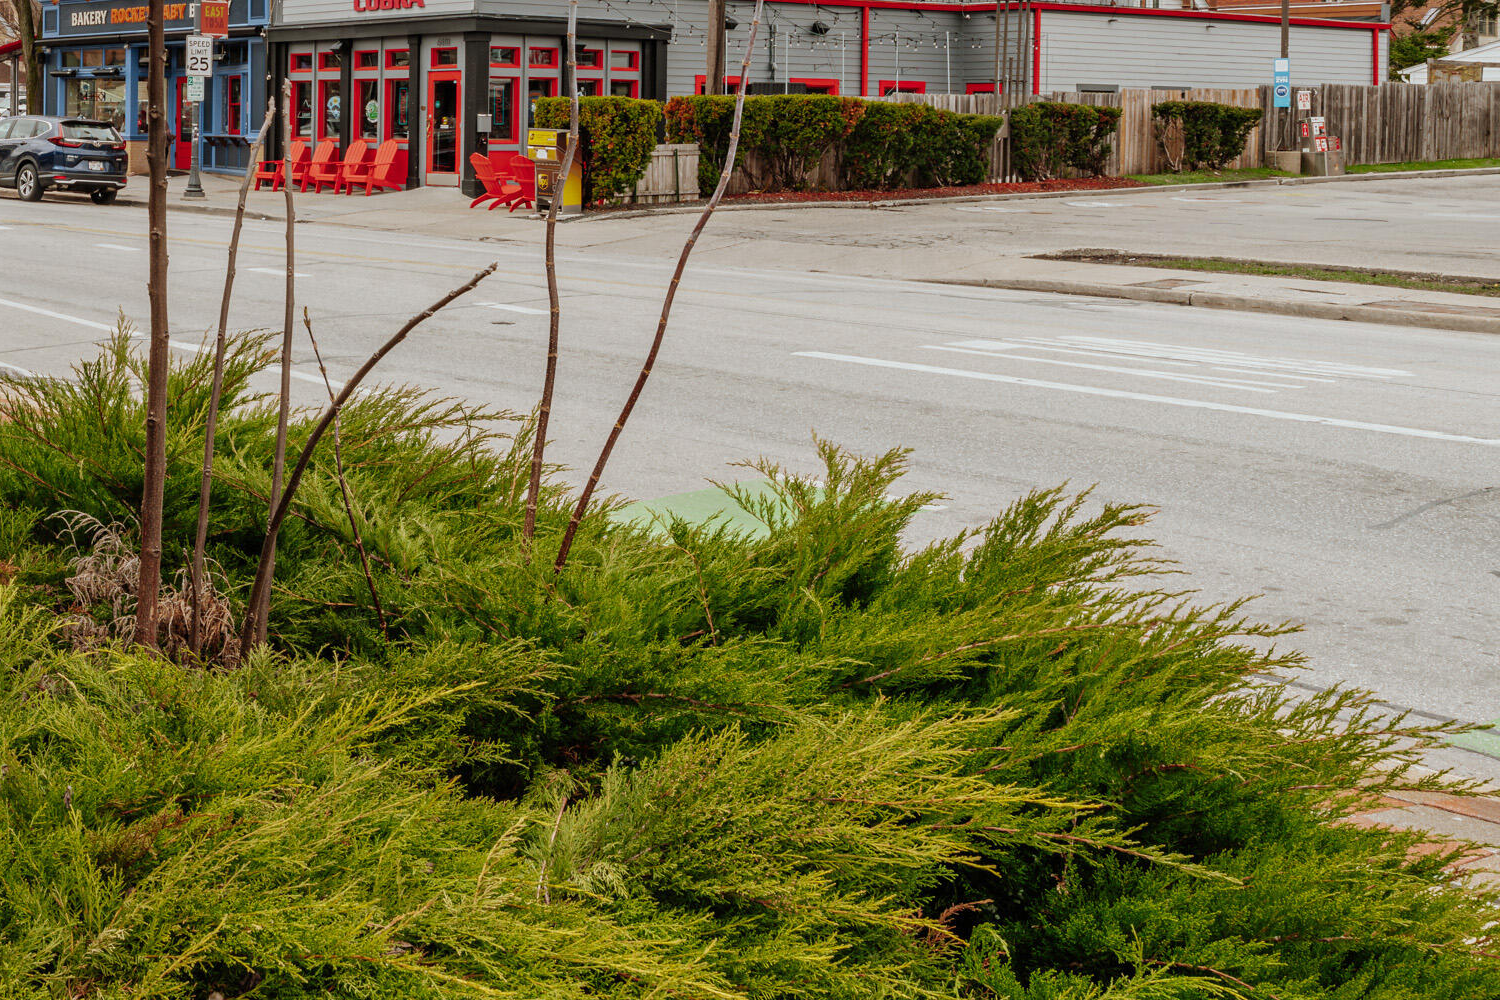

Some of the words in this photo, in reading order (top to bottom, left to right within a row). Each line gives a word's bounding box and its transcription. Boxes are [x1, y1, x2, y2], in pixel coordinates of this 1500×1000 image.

[71, 10, 108, 26] BAKERY
[162, 3, 187, 19] ABY
[205, 6, 224, 18] EAST
[190, 57, 209, 71] 25
